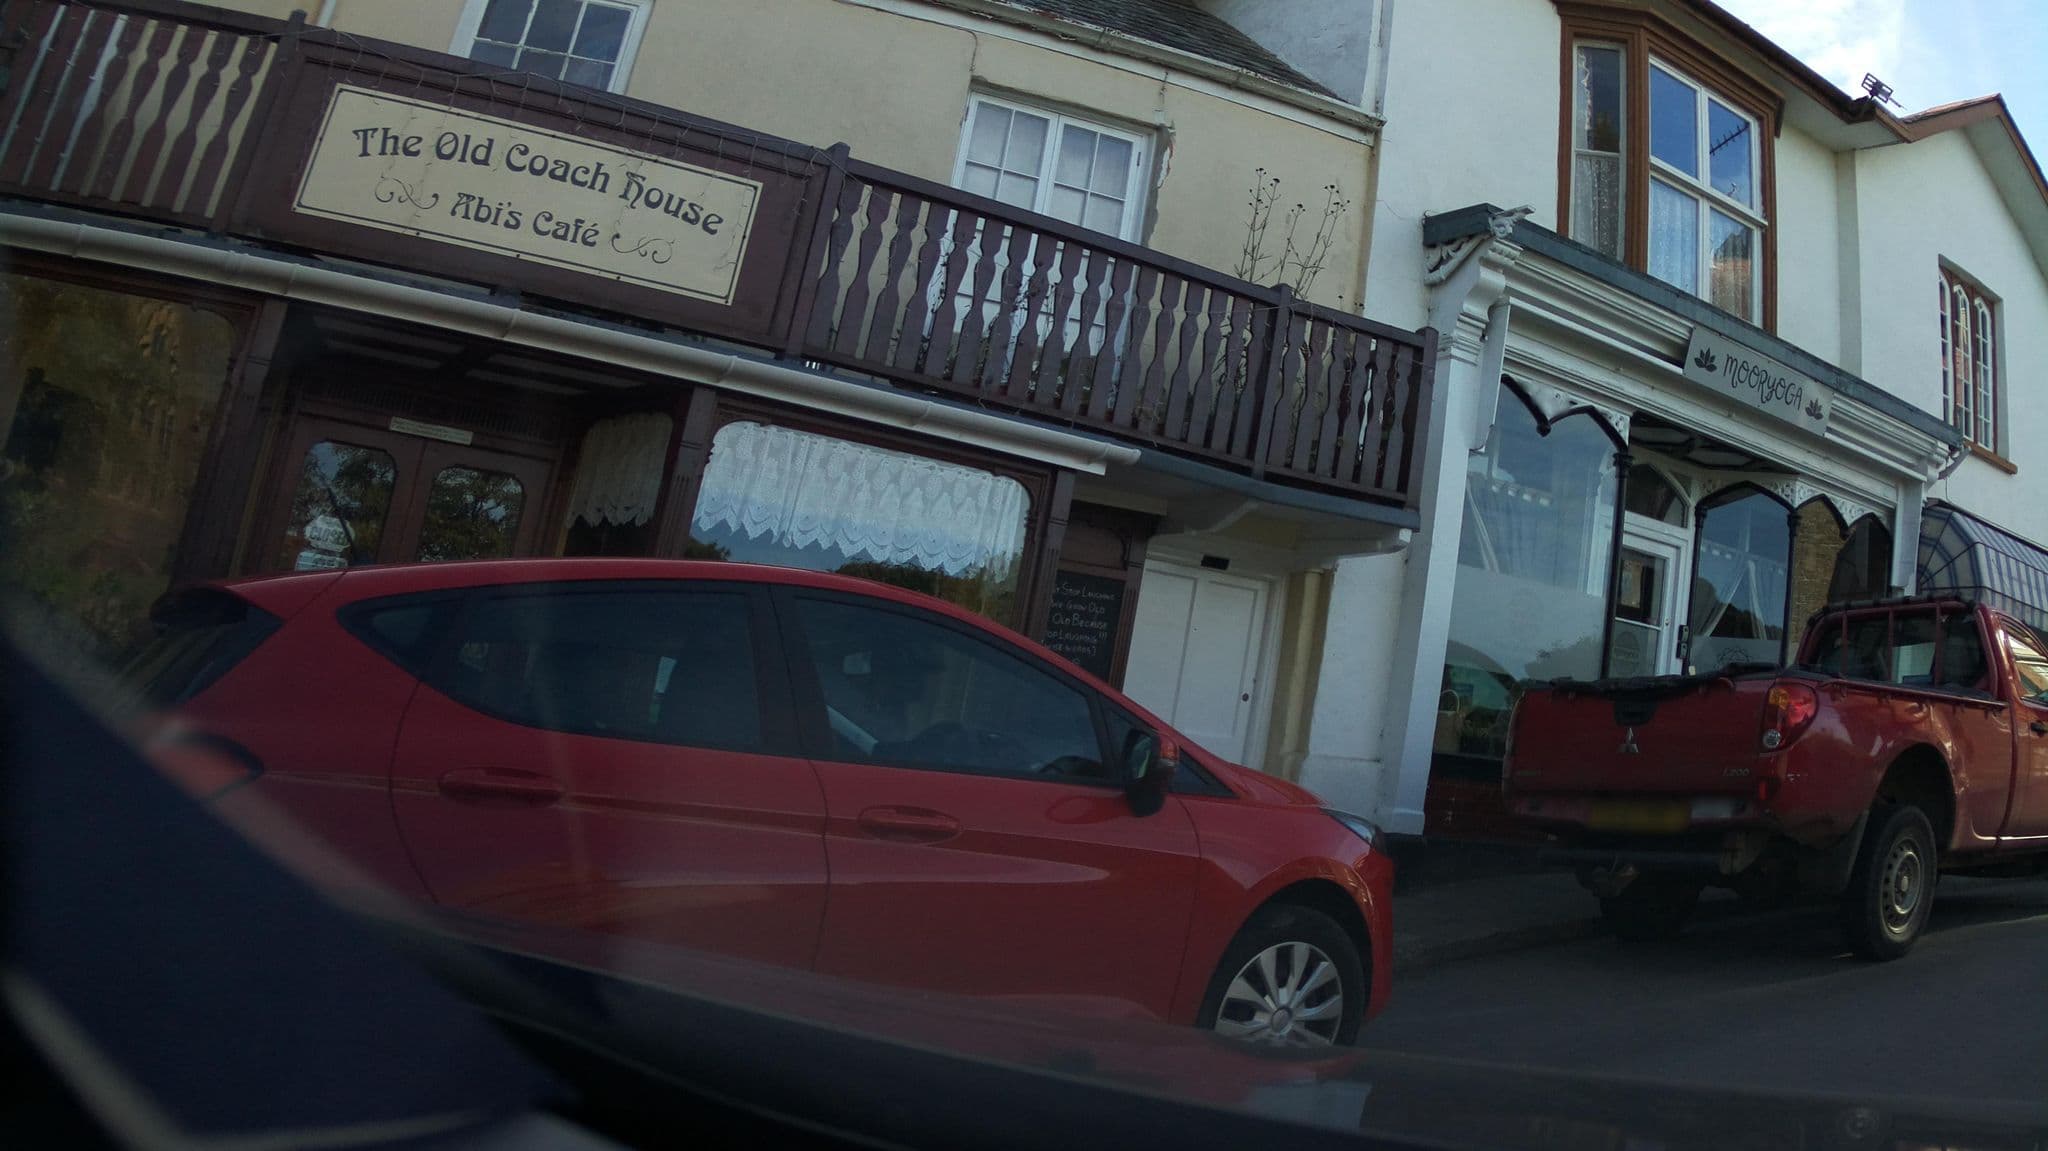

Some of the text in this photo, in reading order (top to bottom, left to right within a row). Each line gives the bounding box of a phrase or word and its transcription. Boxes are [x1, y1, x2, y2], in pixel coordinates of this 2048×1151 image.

[352, 127, 423, 158] The
[434, 131, 494, 167] Old
[505, 143, 610, 193] Coach
[450, 191, 600, 247] Abi's Café
